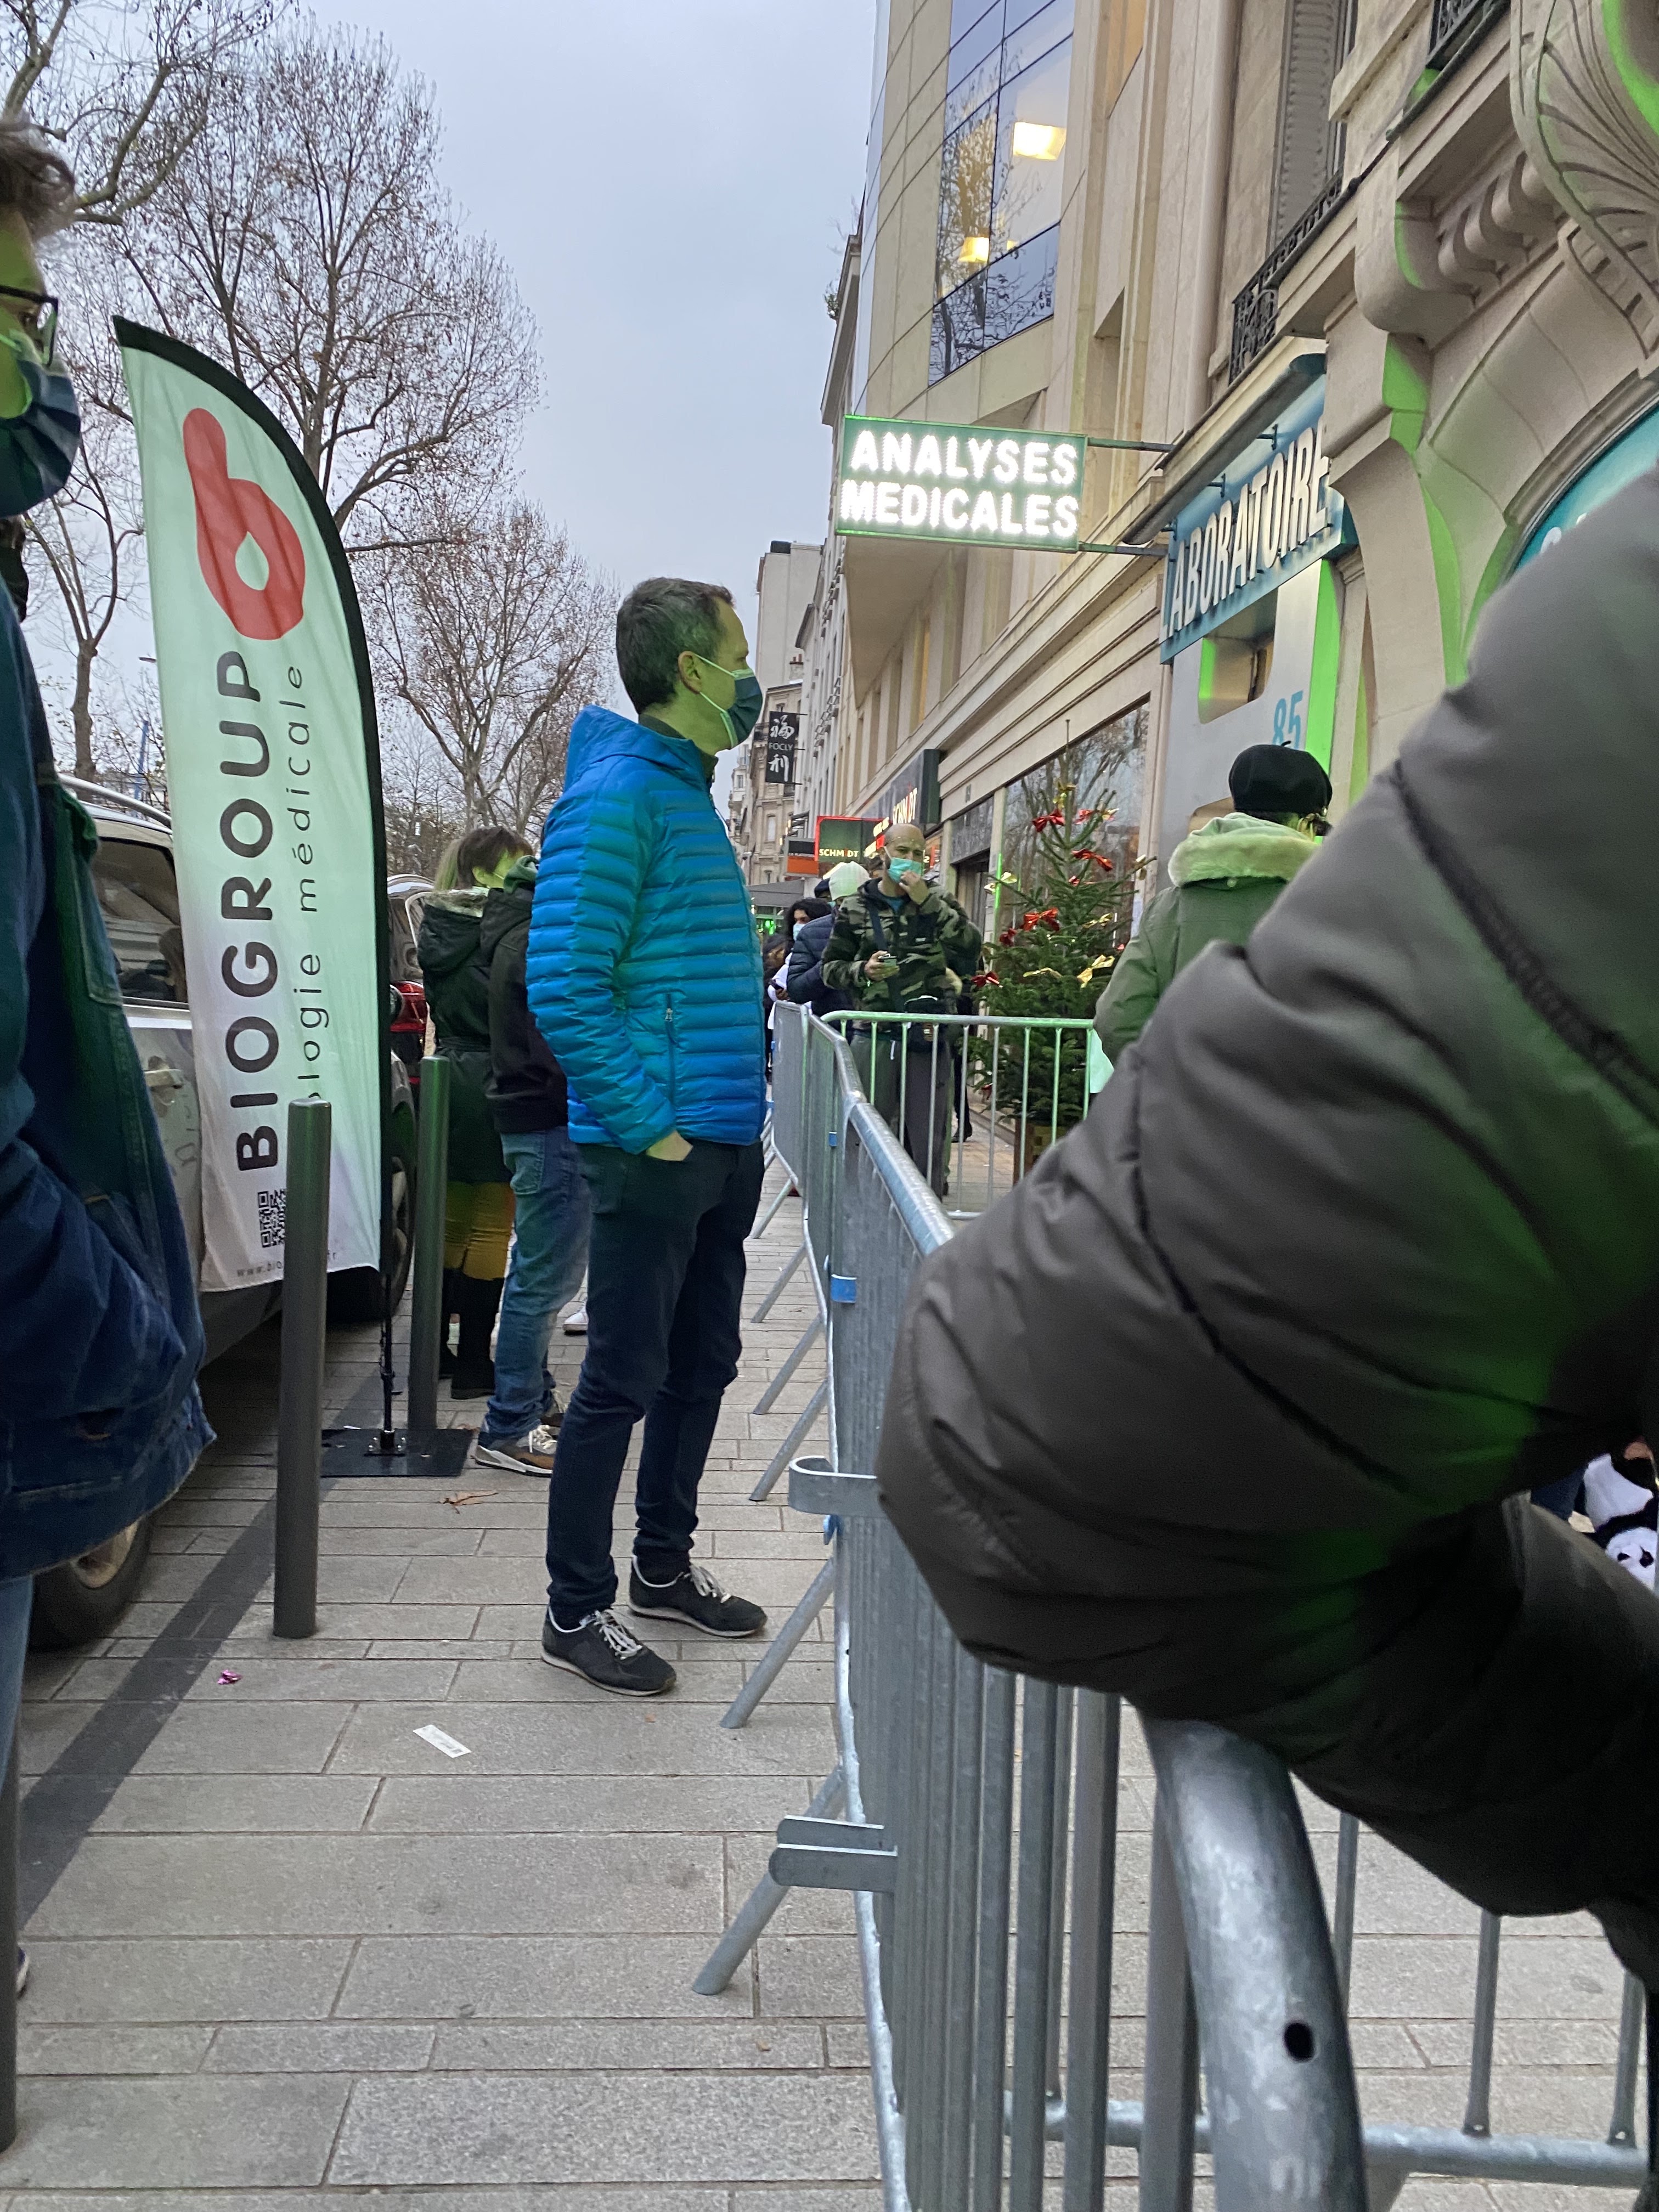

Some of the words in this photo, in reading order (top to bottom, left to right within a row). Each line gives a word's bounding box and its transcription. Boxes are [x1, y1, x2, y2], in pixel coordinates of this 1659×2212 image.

[839, 479, 1080, 538] MEDICALES
[850, 429, 1079, 486] ANALYSES
[1159, 416, 1330, 644] LABORATOIRE
[279, 665, 318, 913] médicale
[769, 742, 794, 751] FOCLY
[217, 650, 279, 1171] BIOGROUP
